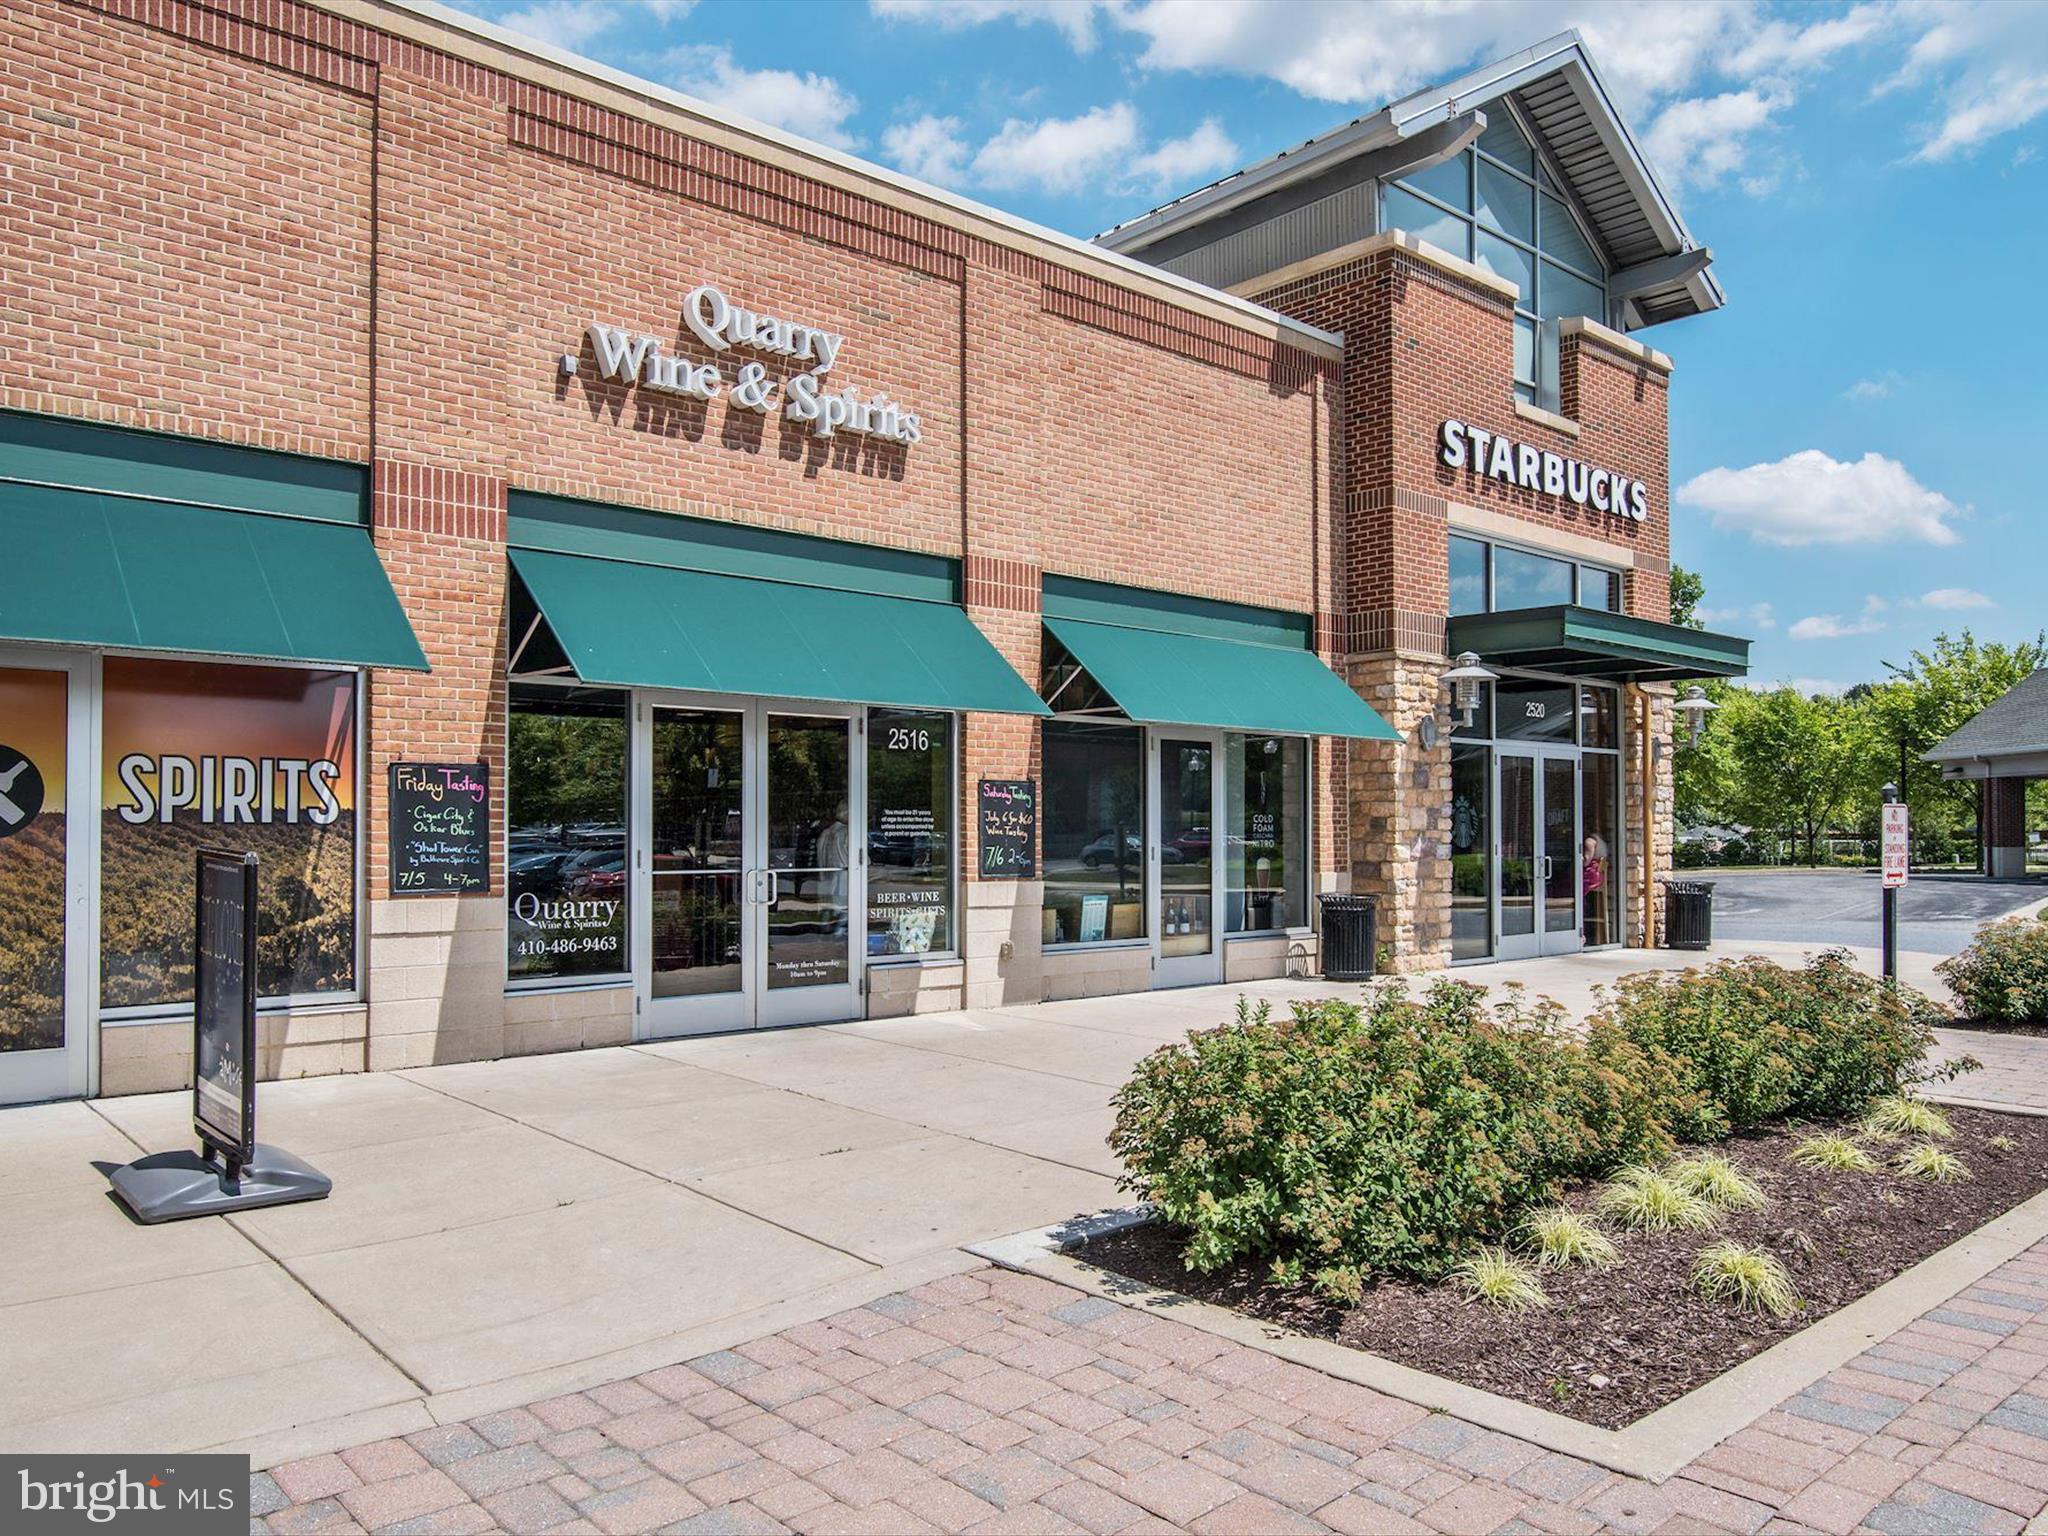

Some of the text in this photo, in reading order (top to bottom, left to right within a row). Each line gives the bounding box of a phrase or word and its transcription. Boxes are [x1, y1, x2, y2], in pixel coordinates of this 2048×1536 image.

[682, 285, 845, 375] Quarry
[586, 322, 924, 445] Wine & Spirits
[1440, 419, 1647, 522] STARBUCKS
[1526, 702, 1545, 718] 2520
[889, 728, 929, 750] 2516
[117, 753, 341, 825] SPIRITS
[397, 767, 484, 803] Friday Tasting
[983, 783, 1012, 805] Saturday
[414, 805, 441, 823] Cigar
[443, 807, 464, 826] City
[984, 810, 1000, 826] July
[1253, 814, 1274, 823] COLD
[986, 825, 1003, 835] Wine
[1252, 823, 1274, 832] FOAM
[437, 841, 463, 854] Tower
[1252, 839, 1275, 848] NITRO
[409, 856, 419, 867] by
[985, 845, 1004, 867] 7/6
[399, 870, 426, 886] 7/5
[877, 891, 940, 904] BEER WINE
[514, 892, 620, 927] Quarry
[537, 918, 602, 931] Wine & Spirits
[517, 936, 618, 956] 410-486-9463
